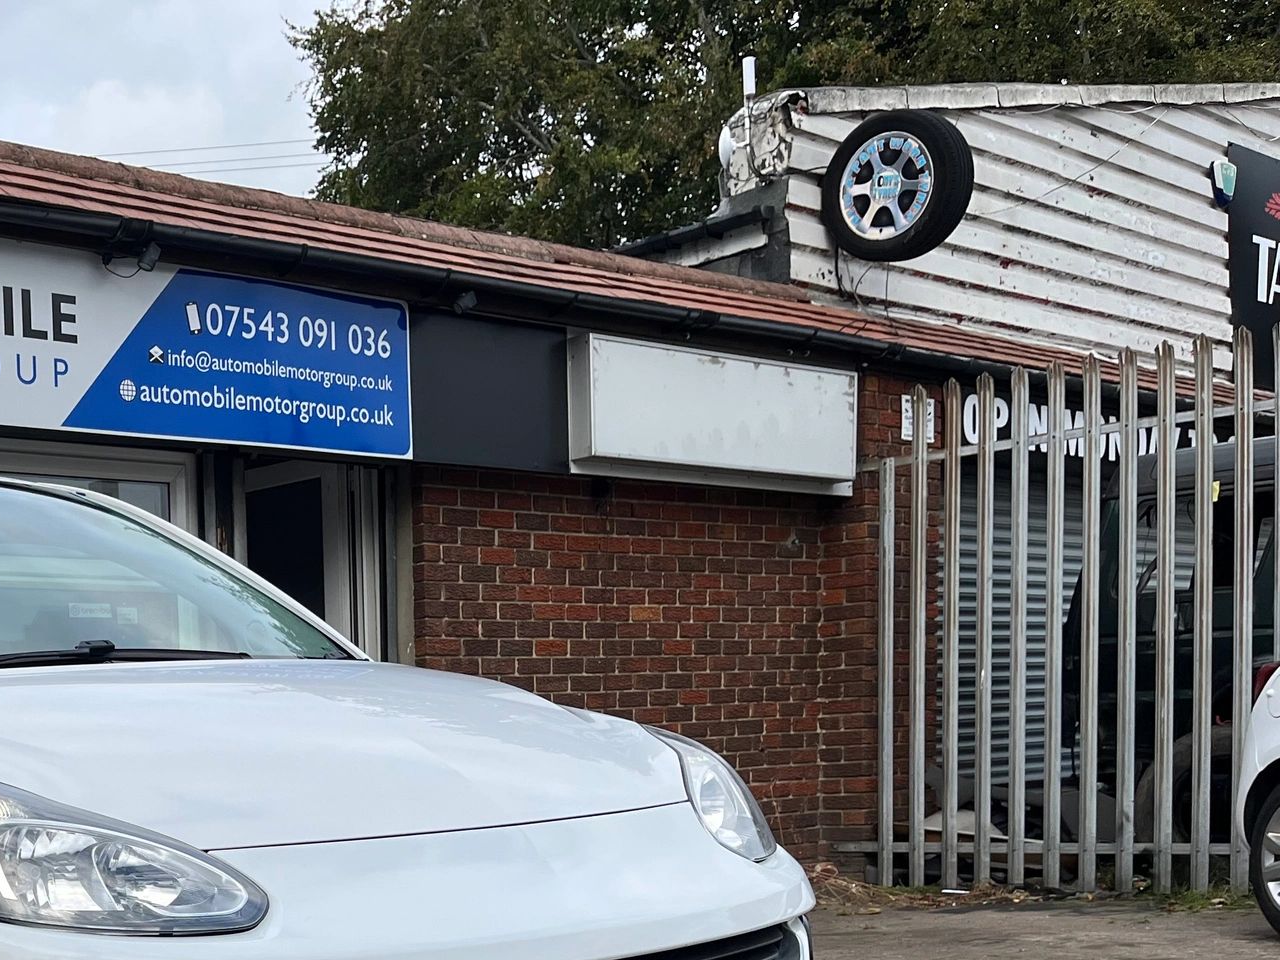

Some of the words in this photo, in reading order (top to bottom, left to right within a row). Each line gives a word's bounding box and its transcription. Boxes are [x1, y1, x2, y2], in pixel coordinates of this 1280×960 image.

[205, 303, 289, 344] 07543
[298, 316, 336, 351] 091
[347, 324, 391, 358] 036
[167, 350, 393, 392] info@automobilemotorgroup.co.uk
[139, 384, 394, 427] automobilemotorgroup.co.uk
[963, 394, 1048, 453] OPN
